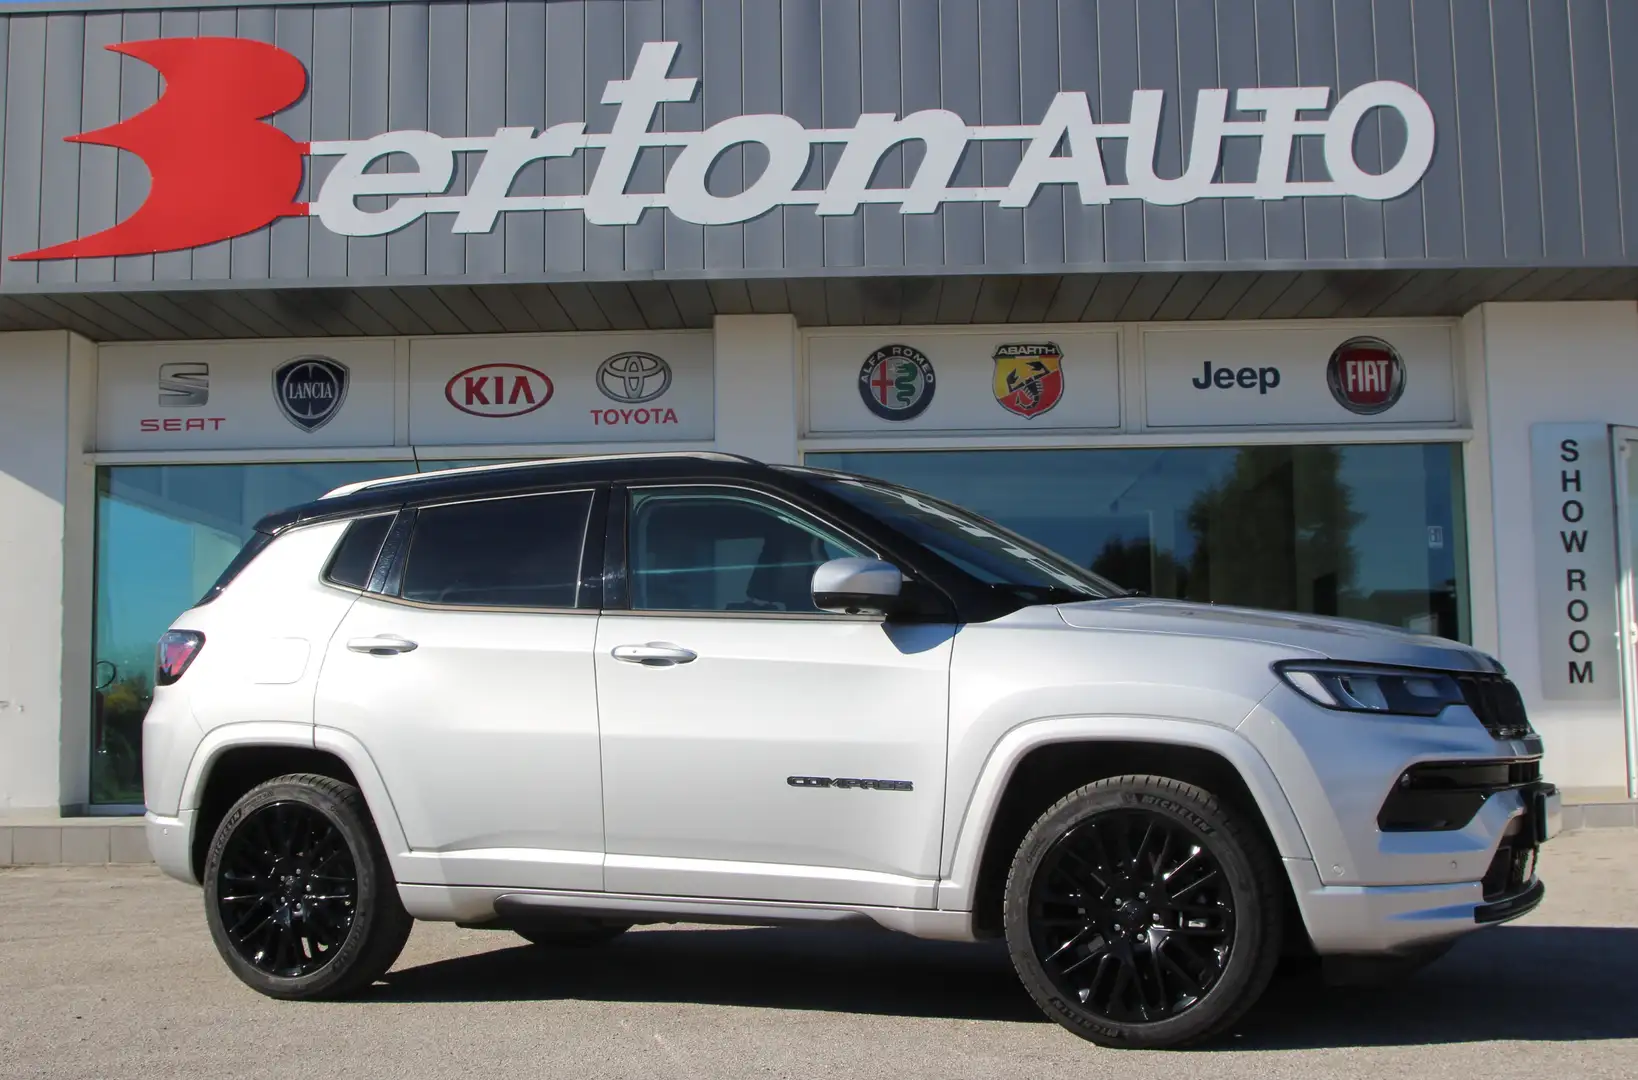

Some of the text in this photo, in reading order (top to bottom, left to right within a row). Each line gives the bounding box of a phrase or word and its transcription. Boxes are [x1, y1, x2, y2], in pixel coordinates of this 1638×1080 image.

[998, 80, 1435, 208] AUTO
[860, 347, 934, 384] ALFA ROMEO
[998, 346, 1056, 356] ABARTH
[288, 382, 333, 399] LANCIA
[464, 375, 536, 405] KIA
[1192, 361, 1281, 395] Jeep
[1346, 360, 1389, 392] FIAT
[140, 418, 226, 432] SEAT
[590, 408, 679, 425] TOYOTA
[1141, 793, 1213, 833] MICHELIN
